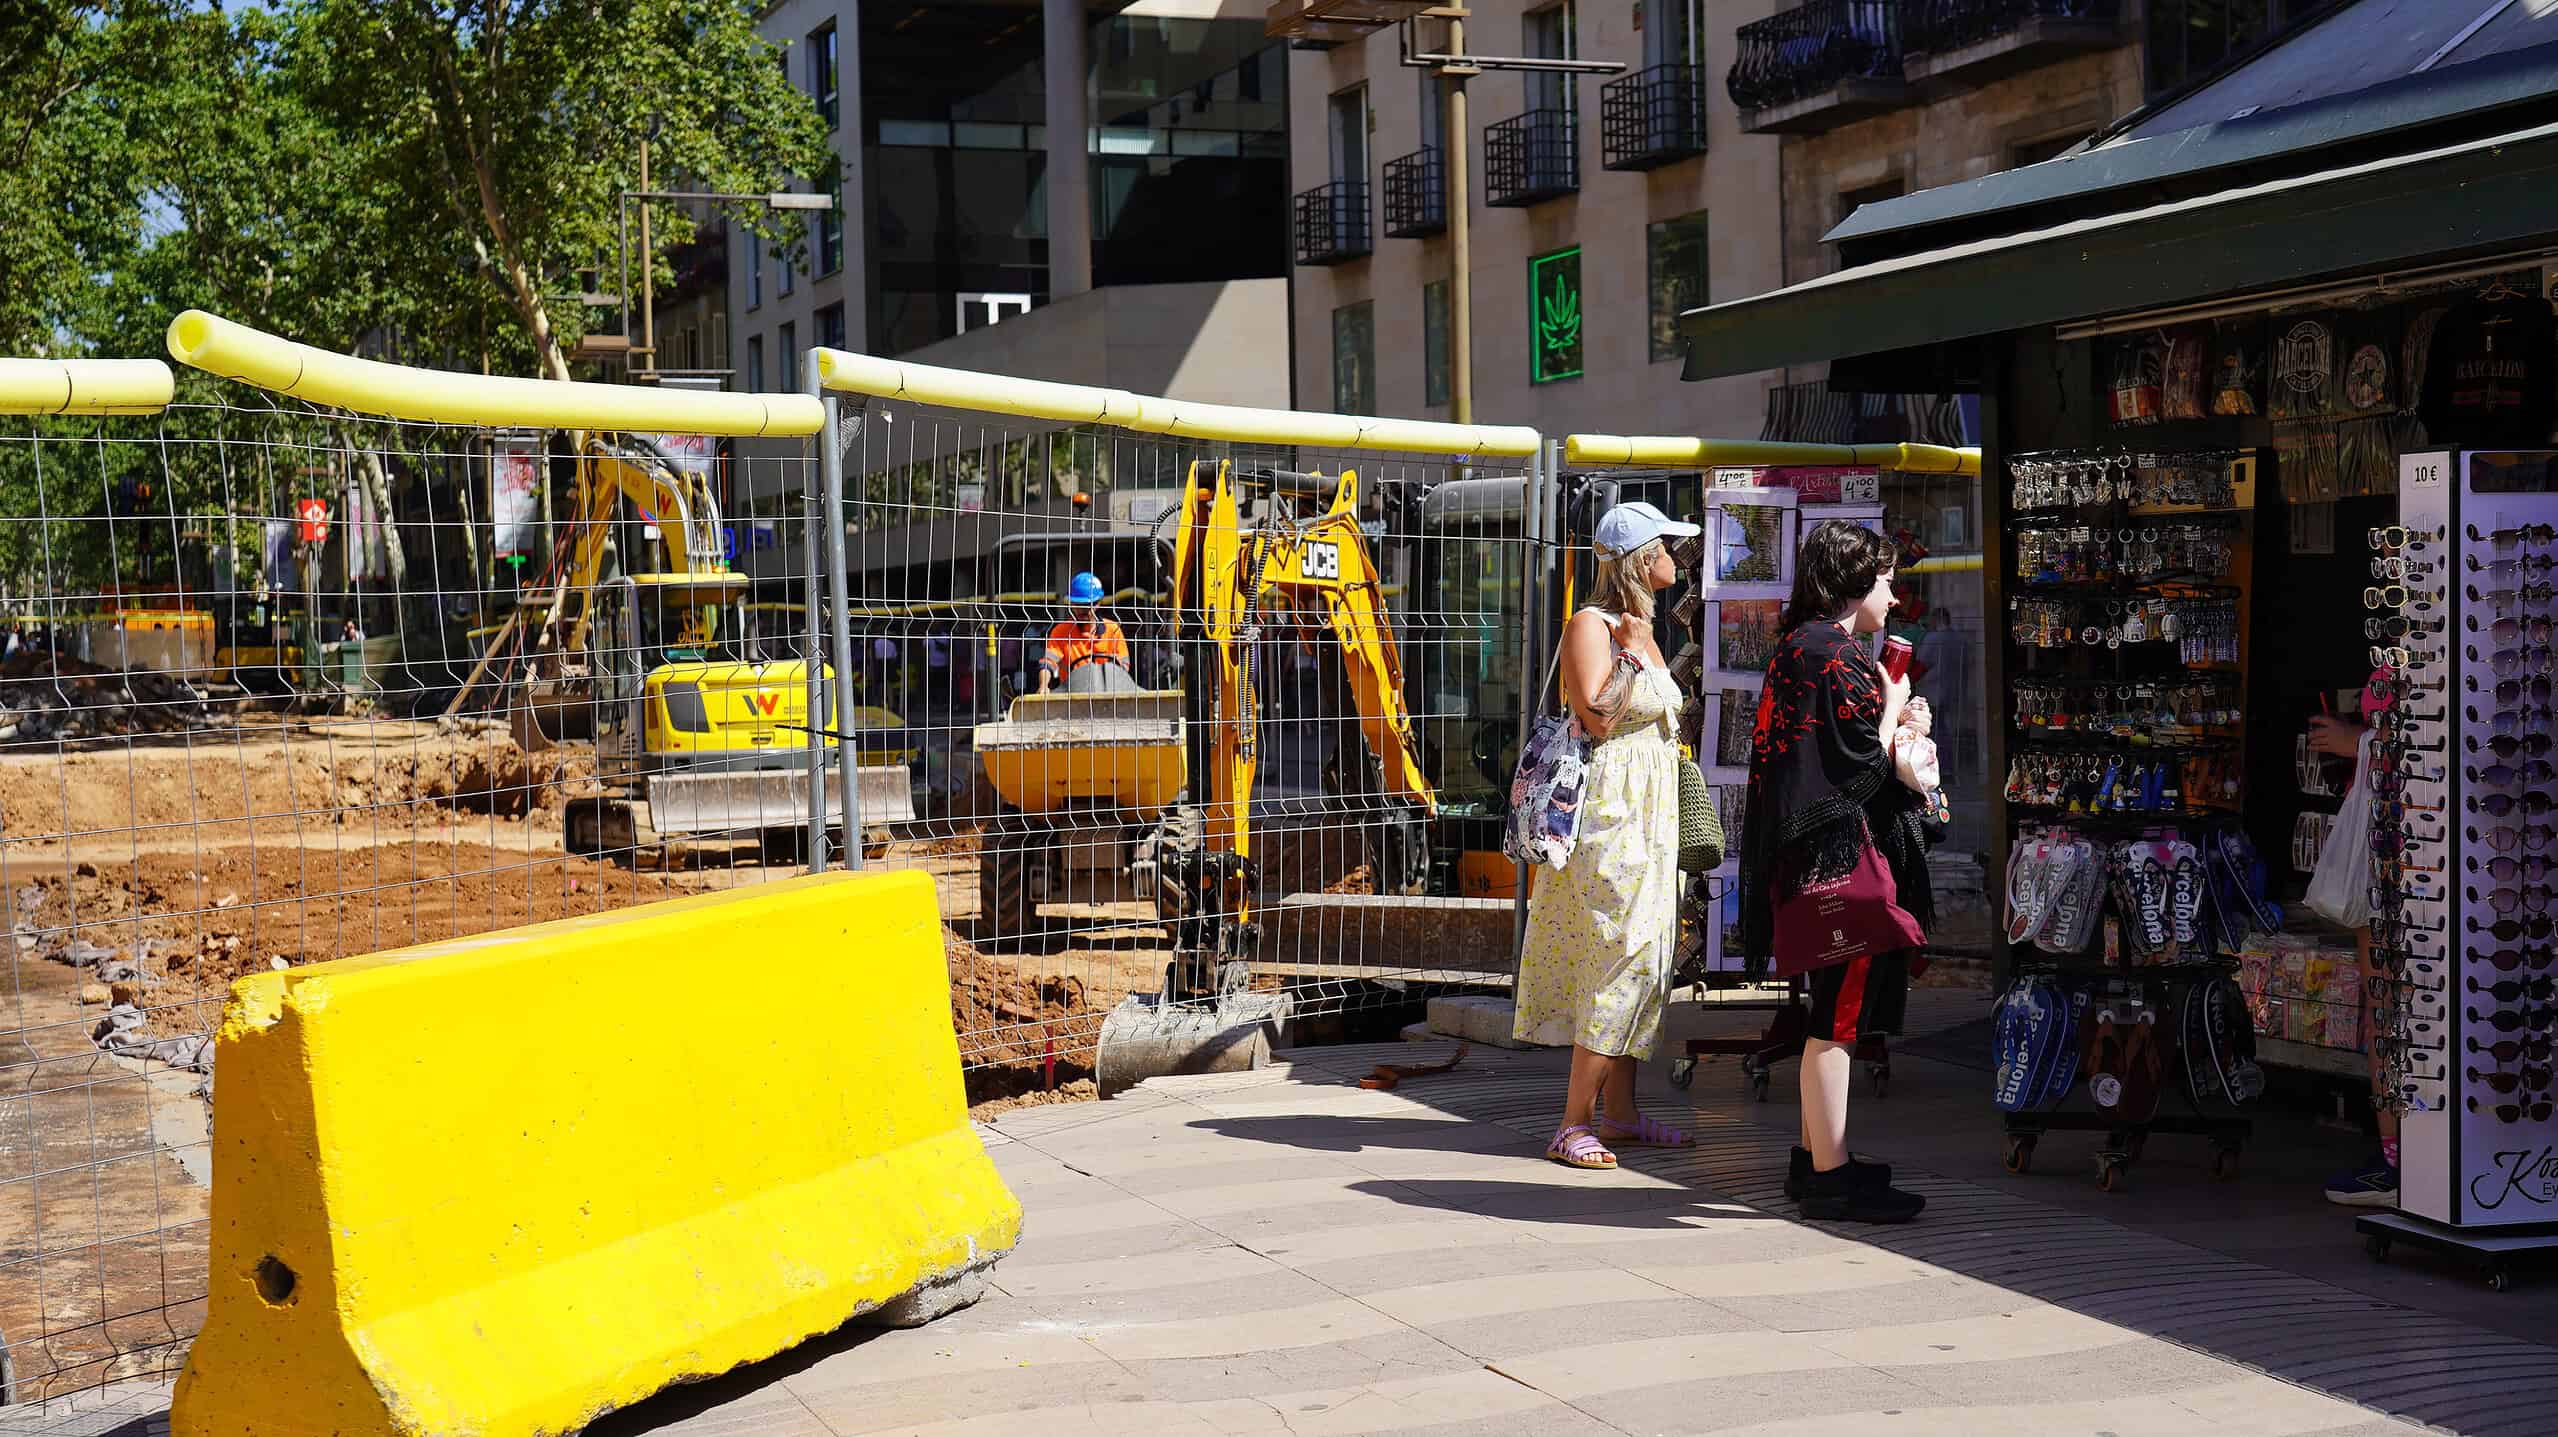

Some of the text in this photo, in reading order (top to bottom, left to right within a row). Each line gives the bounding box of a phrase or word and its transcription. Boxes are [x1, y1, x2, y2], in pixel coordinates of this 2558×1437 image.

[2415, 465, 2438, 482] 10 €
[1301, 540, 1338, 578] JCB
[2175, 860, 2195, 944] arcelona
